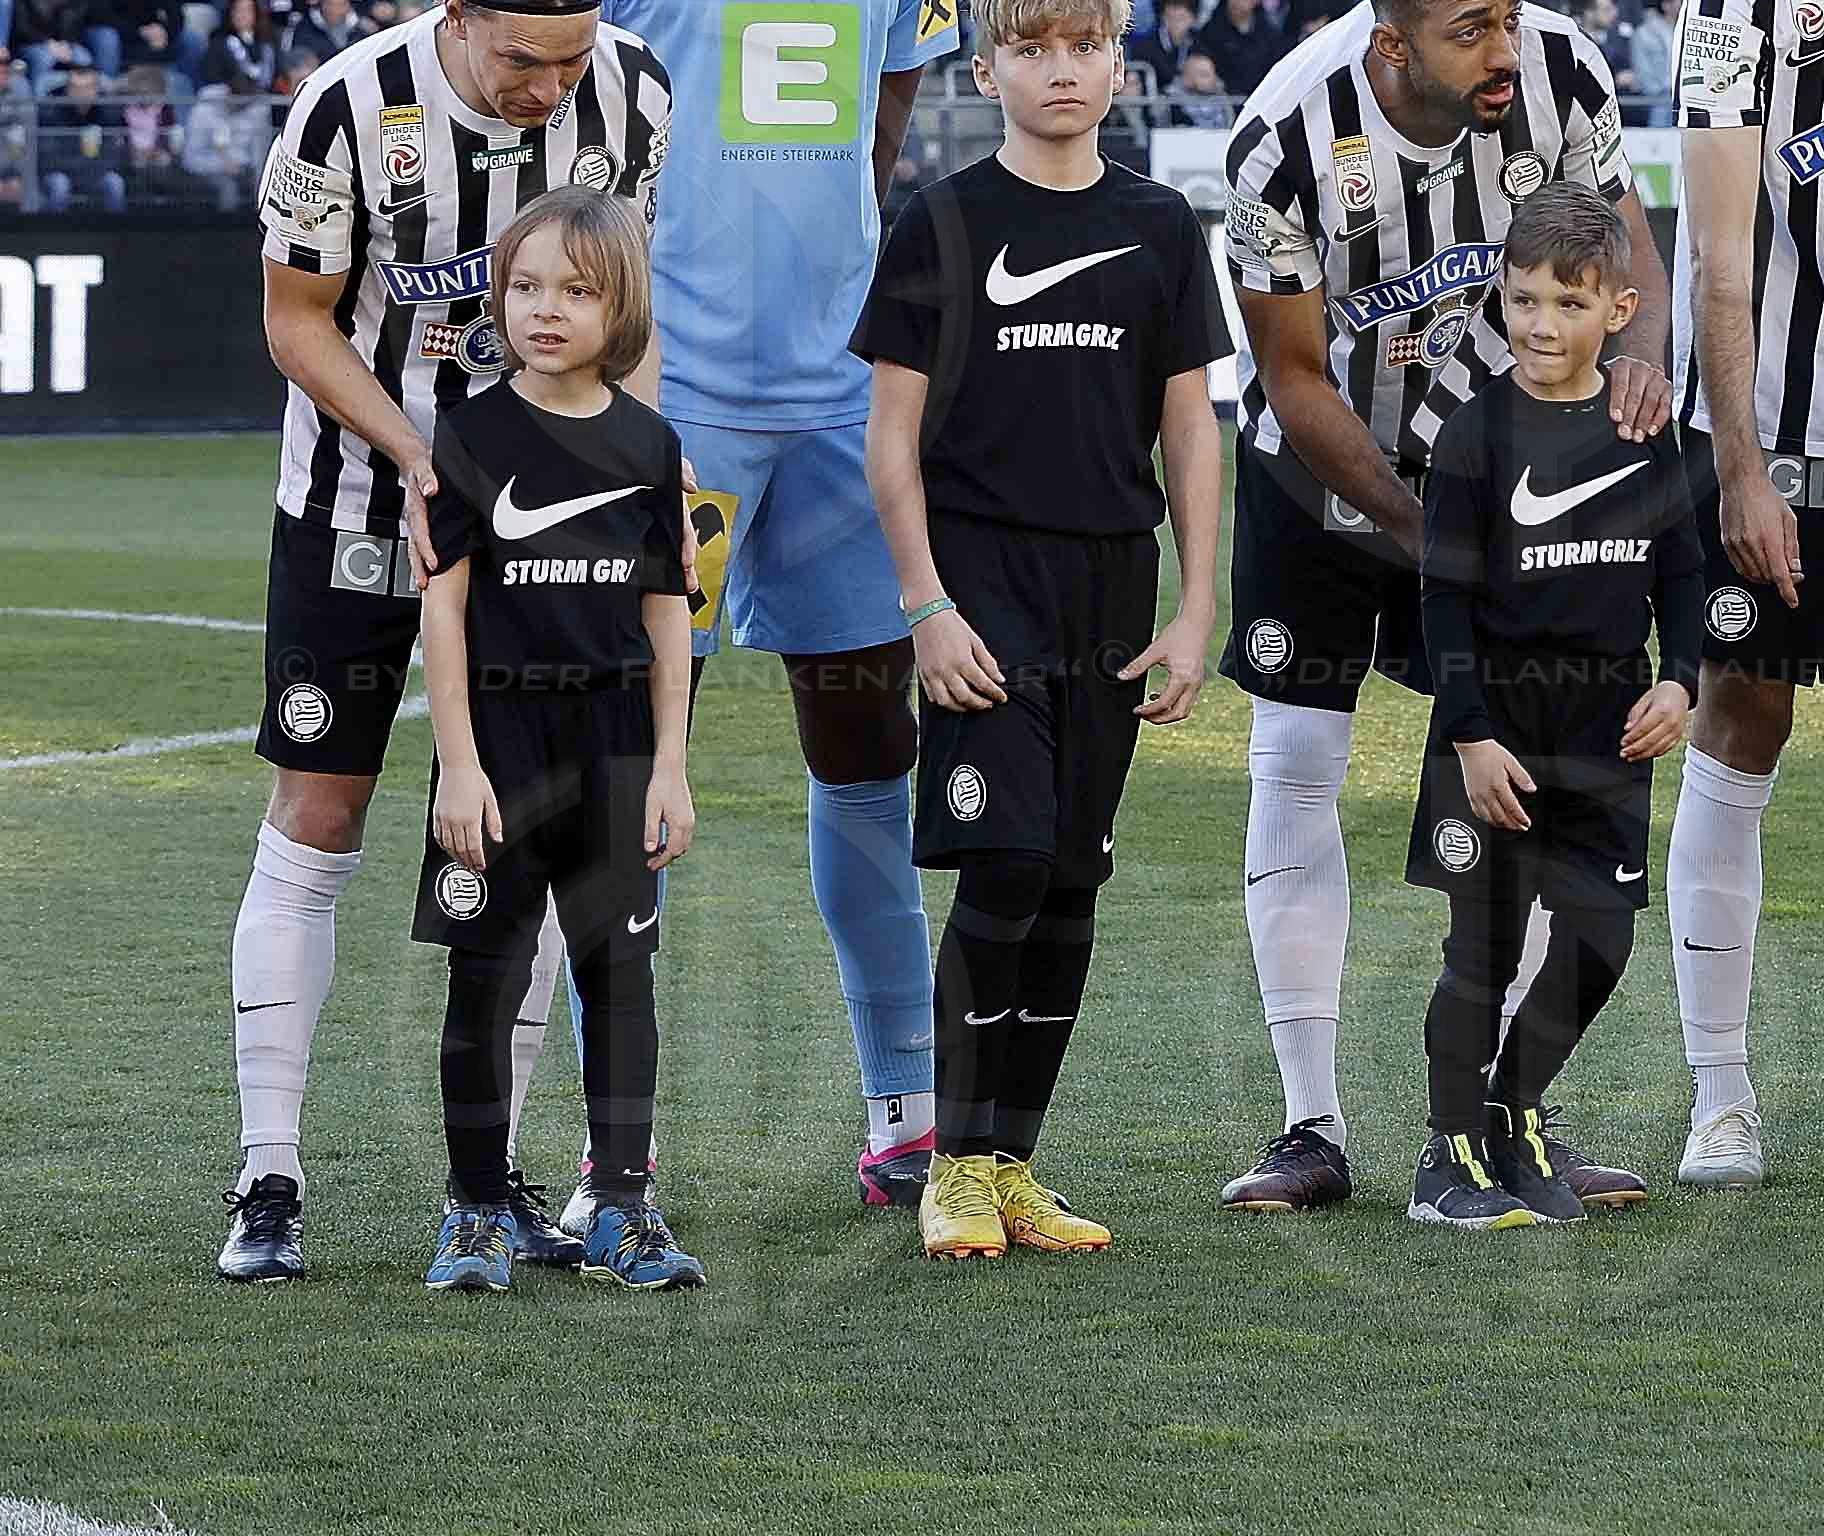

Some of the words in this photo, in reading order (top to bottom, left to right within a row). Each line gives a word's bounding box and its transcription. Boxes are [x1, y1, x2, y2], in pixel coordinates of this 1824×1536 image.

[742, 22, 838, 126] E
[383, 125, 422, 137] BUNDES
[391, 133, 413, 143] LIGA
[489, 150, 533, 169] GRAWE
[720, 149, 777, 161] ENERGIE
[782, 149, 854, 161] STEIERMARK
[1343, 163, 1364, 173] LIGA
[1429, 161, 1465, 189] GRAWE
[997, 322, 1072, 351] STURM
[1521, 541, 1597, 571] STURM
[503, 559, 587, 585] STURM
[593, 558, 636, 584] GR
